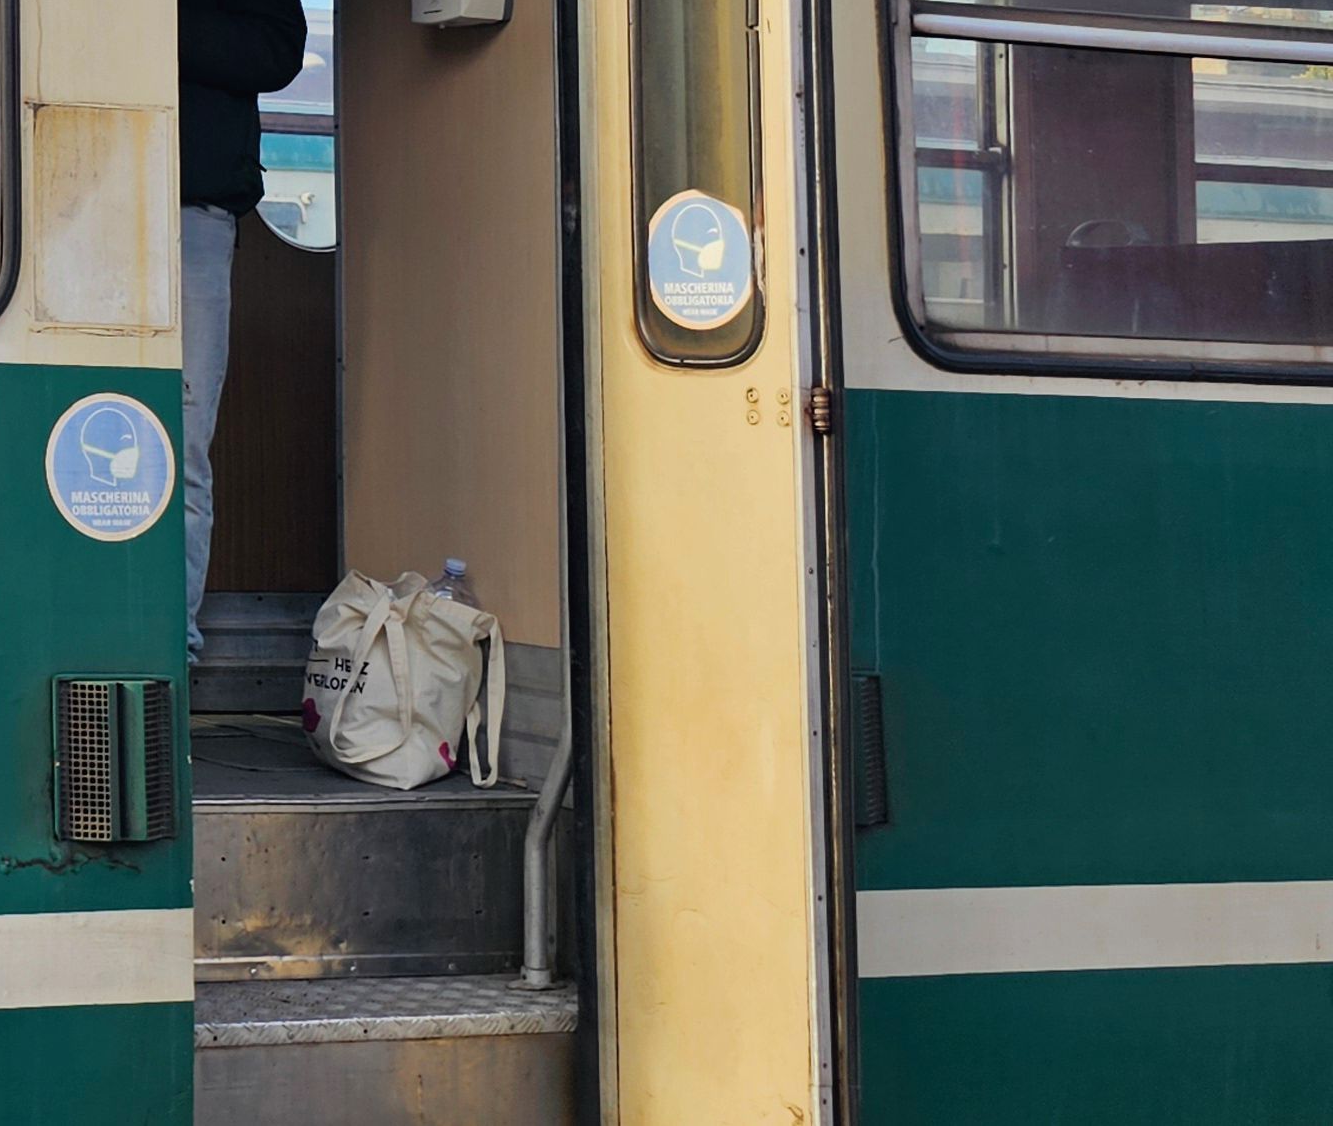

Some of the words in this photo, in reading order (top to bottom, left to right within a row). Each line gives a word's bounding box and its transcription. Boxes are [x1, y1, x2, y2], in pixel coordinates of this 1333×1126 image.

[664, 282, 734, 294] MASCHERINA
[664, 295, 734, 306] OBBLIGATORIA
[71, 491, 151, 503] MASCHERINA
[72, 505, 151, 516] OBBLIGATORIA
[334, 657, 370, 675] HEZ
